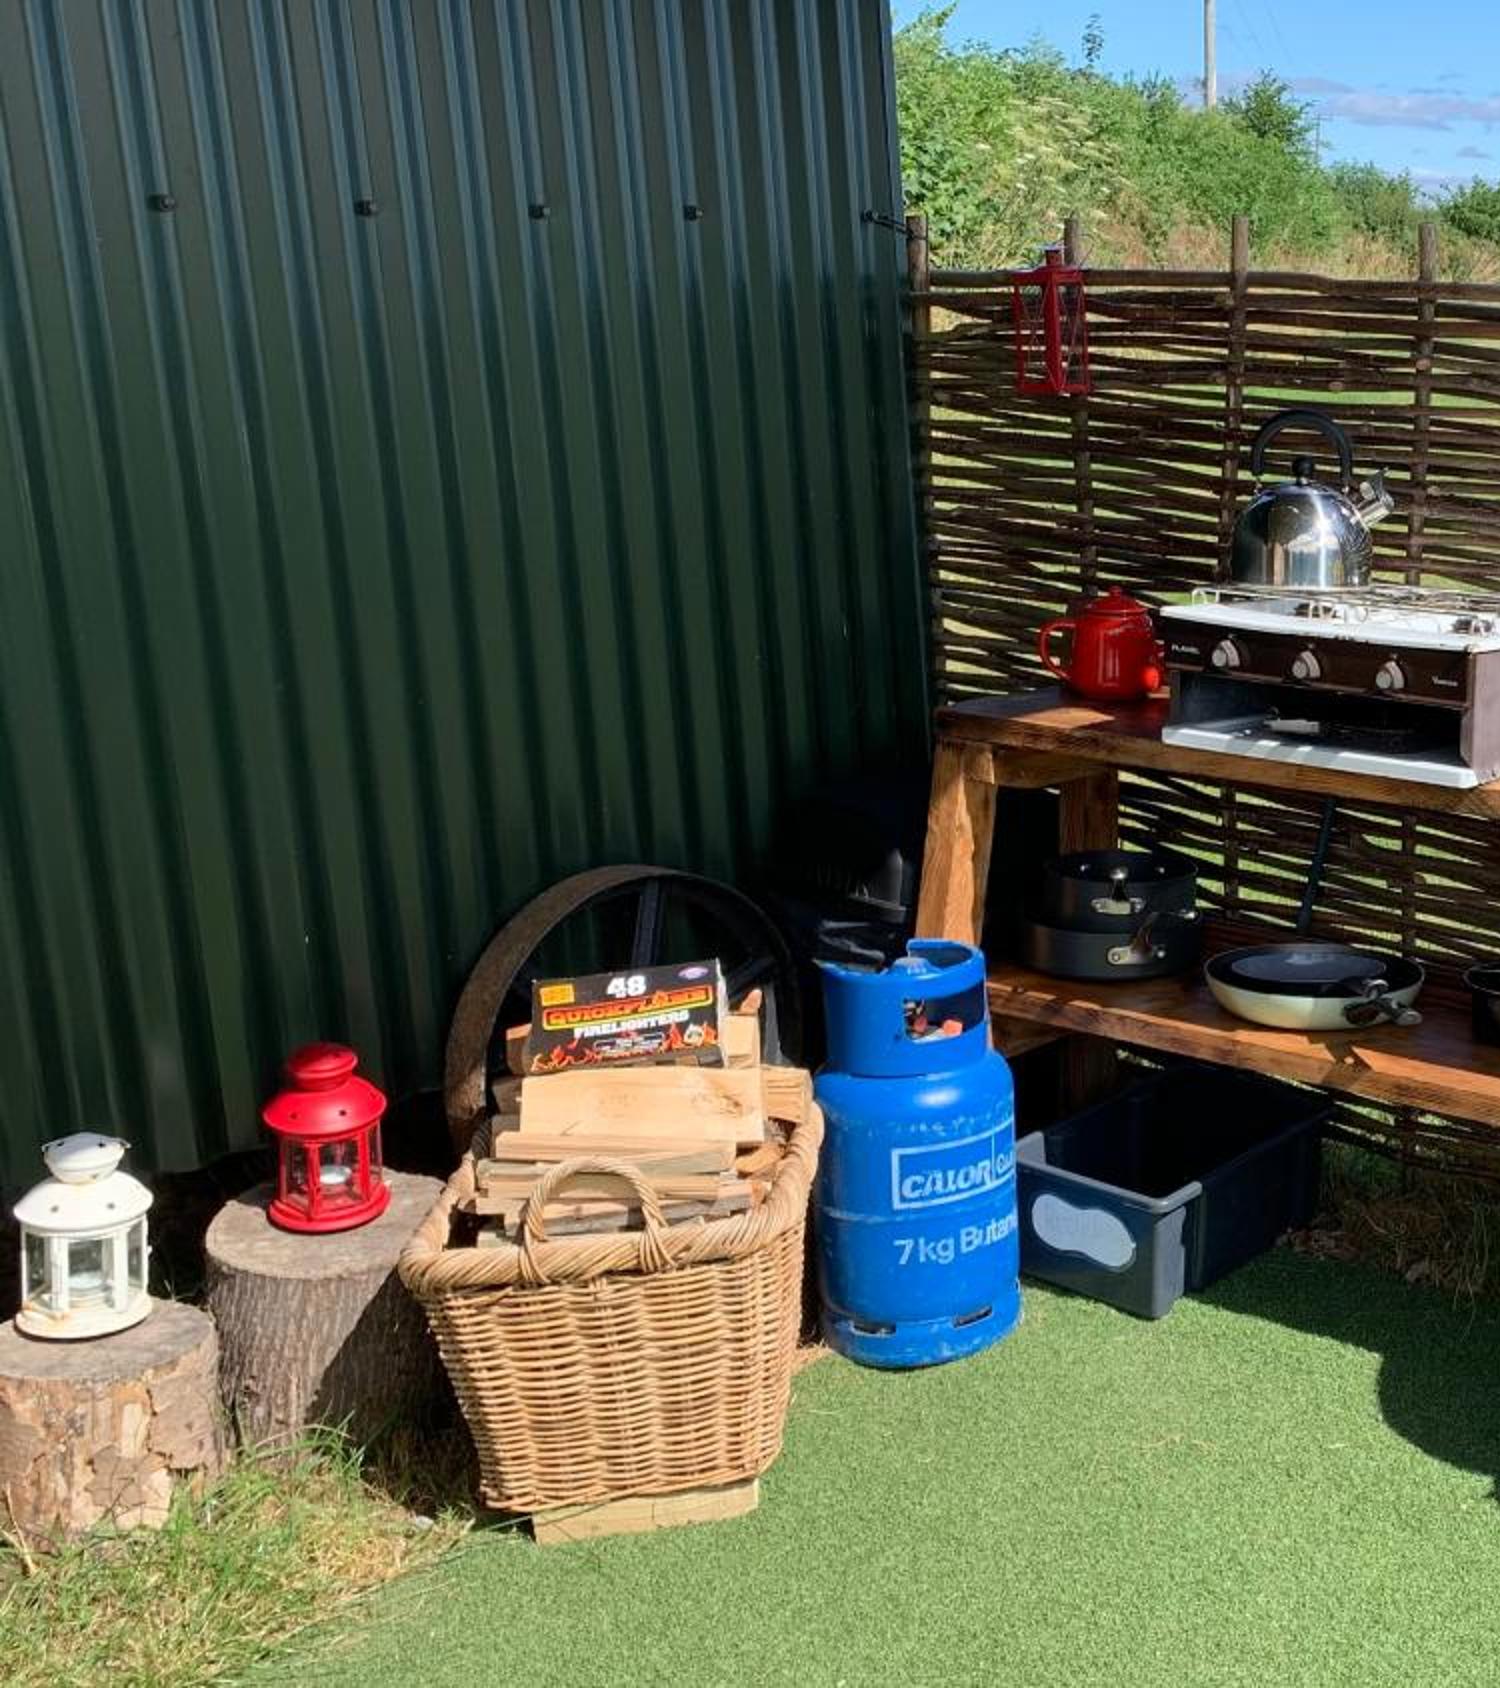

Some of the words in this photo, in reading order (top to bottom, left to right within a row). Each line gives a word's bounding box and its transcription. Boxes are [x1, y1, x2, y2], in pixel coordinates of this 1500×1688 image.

[606, 975, 647, 998] 48
[573, 1009, 690, 1038] FIRELIGHTERS
[960, 1213, 1018, 1253] Butan
